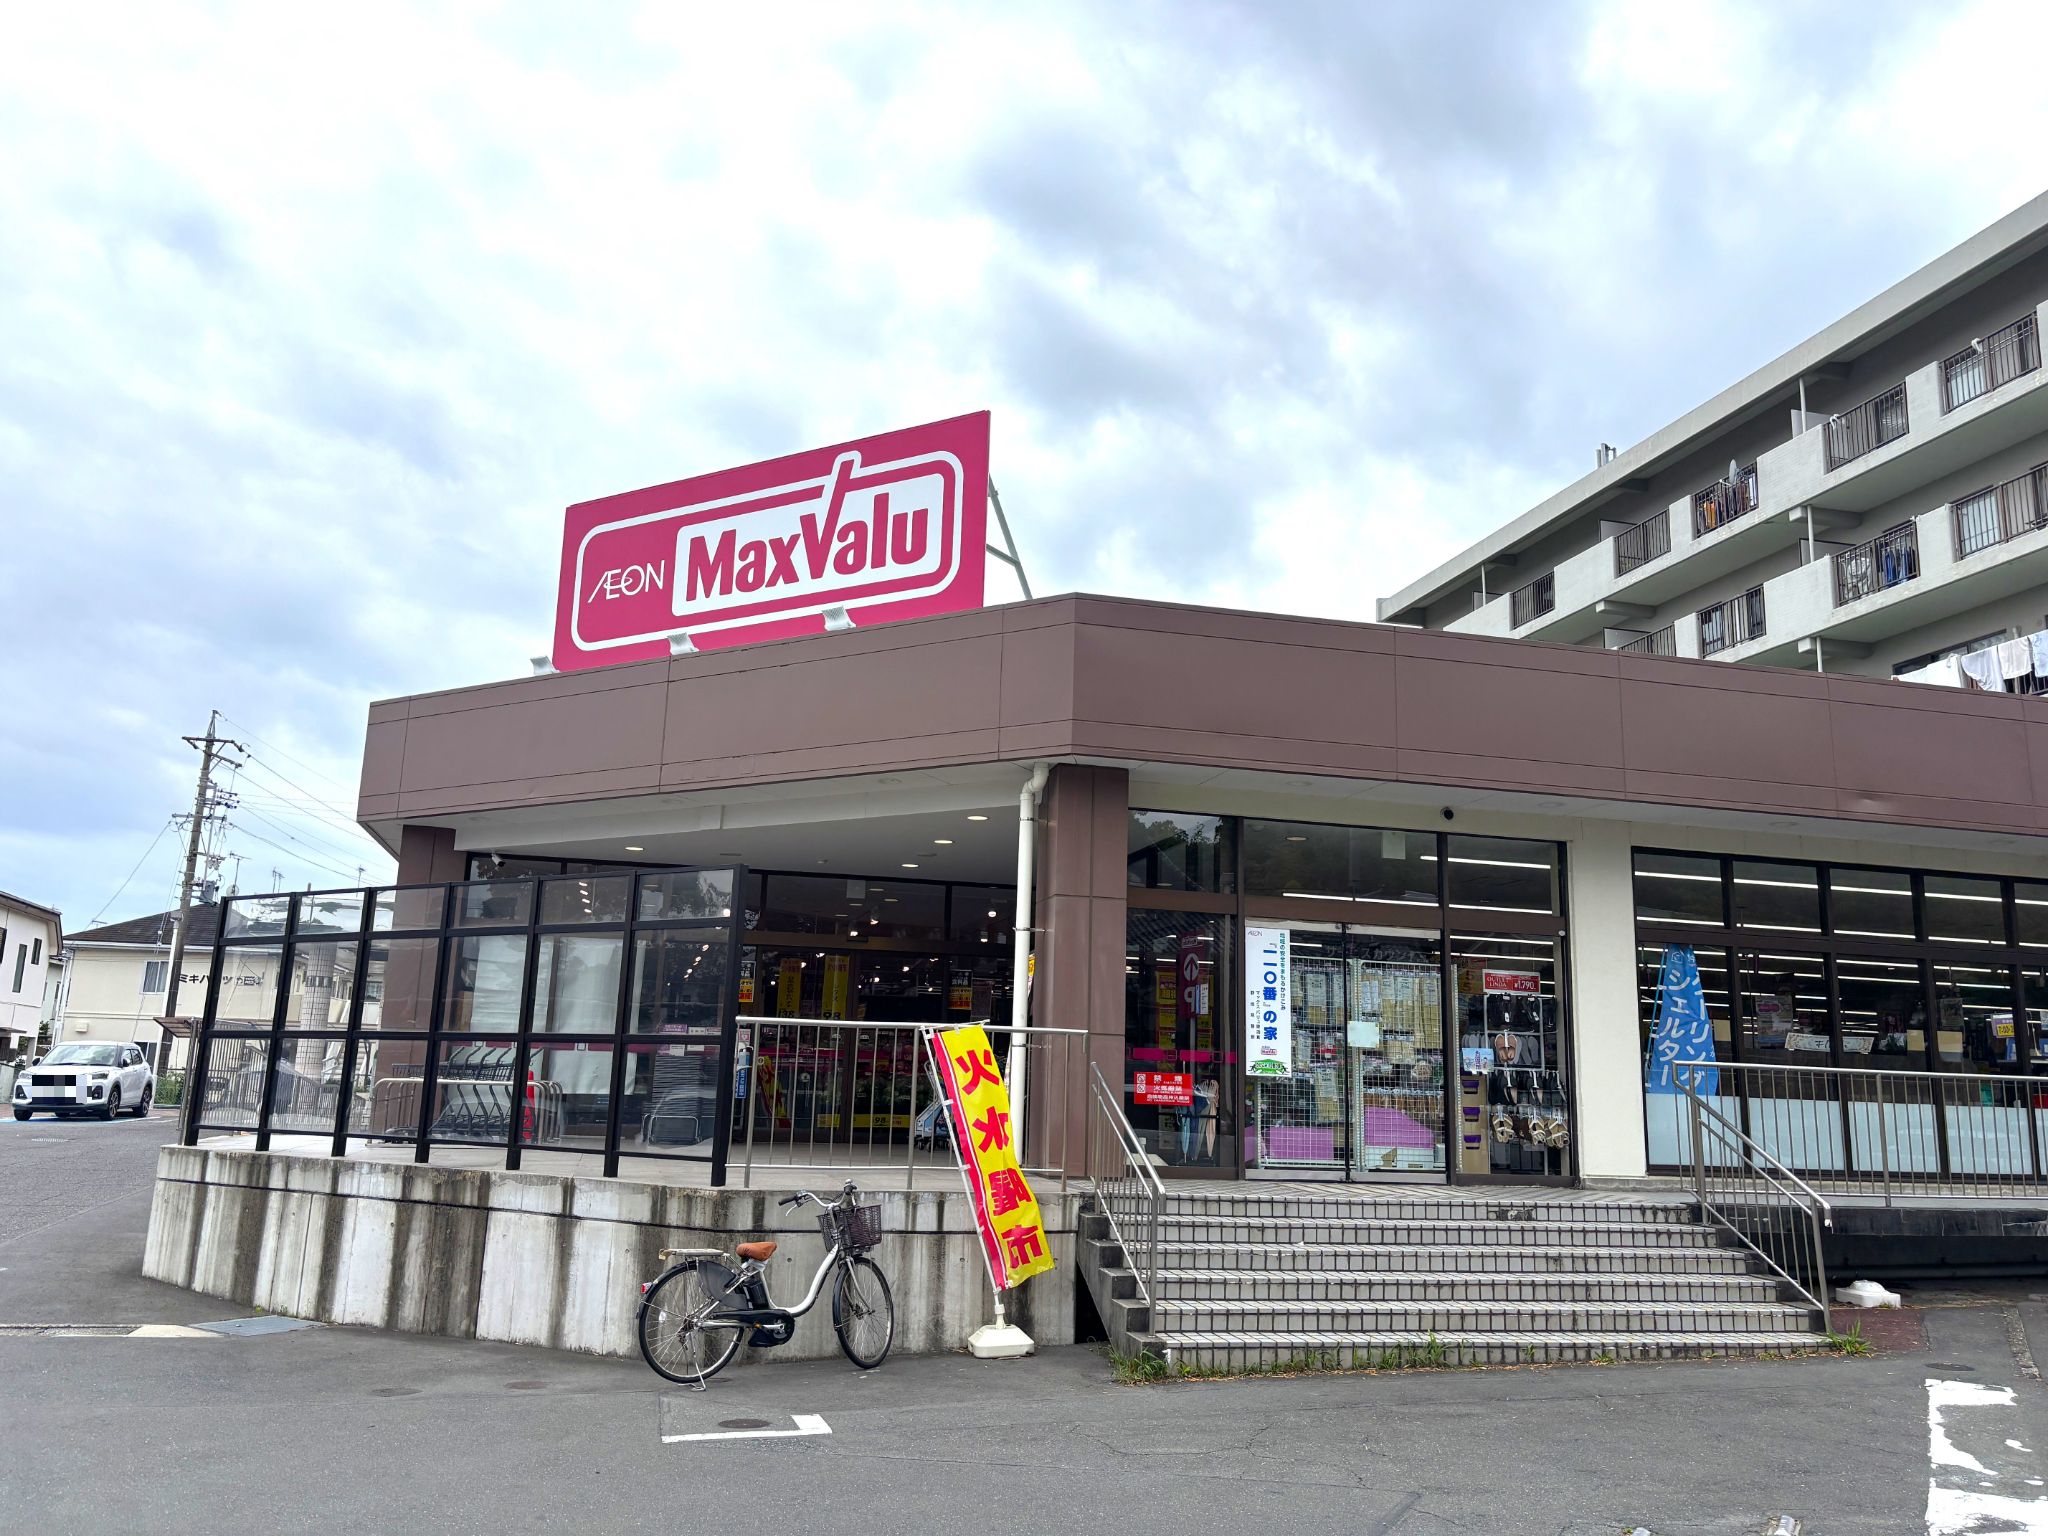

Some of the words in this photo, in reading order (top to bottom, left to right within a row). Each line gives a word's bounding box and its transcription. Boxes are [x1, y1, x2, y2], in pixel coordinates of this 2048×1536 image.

[686, 460, 928, 603] MaxValu
[1658, 969, 1691, 1087] シェルター
